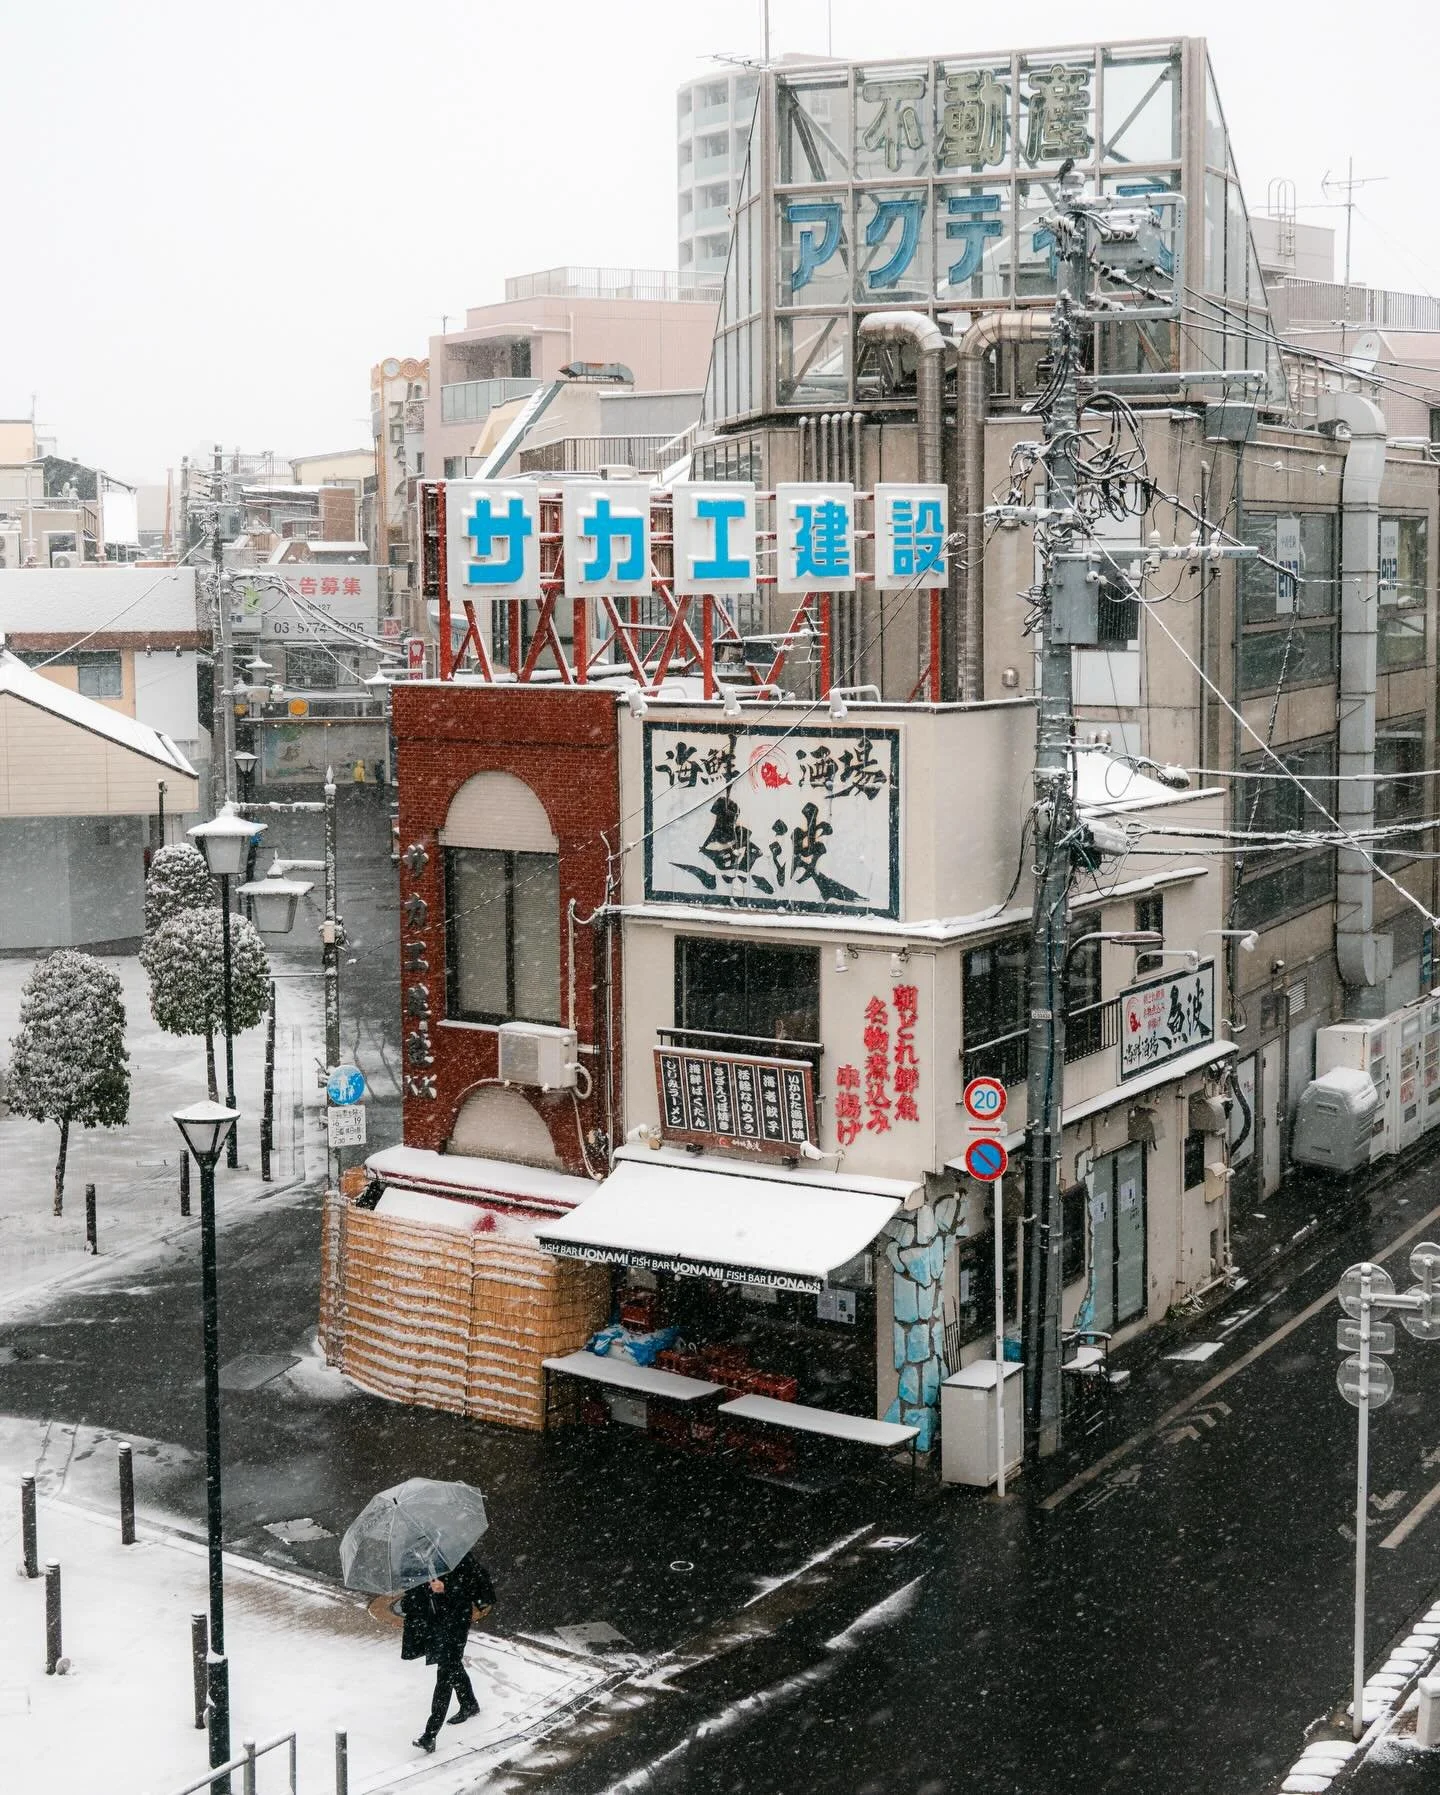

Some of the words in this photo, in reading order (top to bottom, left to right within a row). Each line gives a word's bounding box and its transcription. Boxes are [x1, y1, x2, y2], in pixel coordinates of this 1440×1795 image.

[861, 63, 1092, 172] 不動産
[466, 495, 947, 585] サカエ建設
[668, 796, 870, 903] 魚波
[1158, 977, 1212, 1050] 魚波
[762, 1074, 780, 1133] 海老餃子
[834, 1064, 863, 1146] 串揚げ
[863, 995, 892, 1135] 名物煮込み
[974, 1090, 998, 1110] 20
[560, 1246, 578, 1256] BAR
[578, 1247, 629, 1265] UONAMI
[631, 1256, 651, 1267] FISH
[651, 1259, 671, 1270] BAR
[670, 1261, 724, 1280] UONAMI
[726, 1270, 746, 1281] FISH
[748, 1272, 767, 1284] BAR
